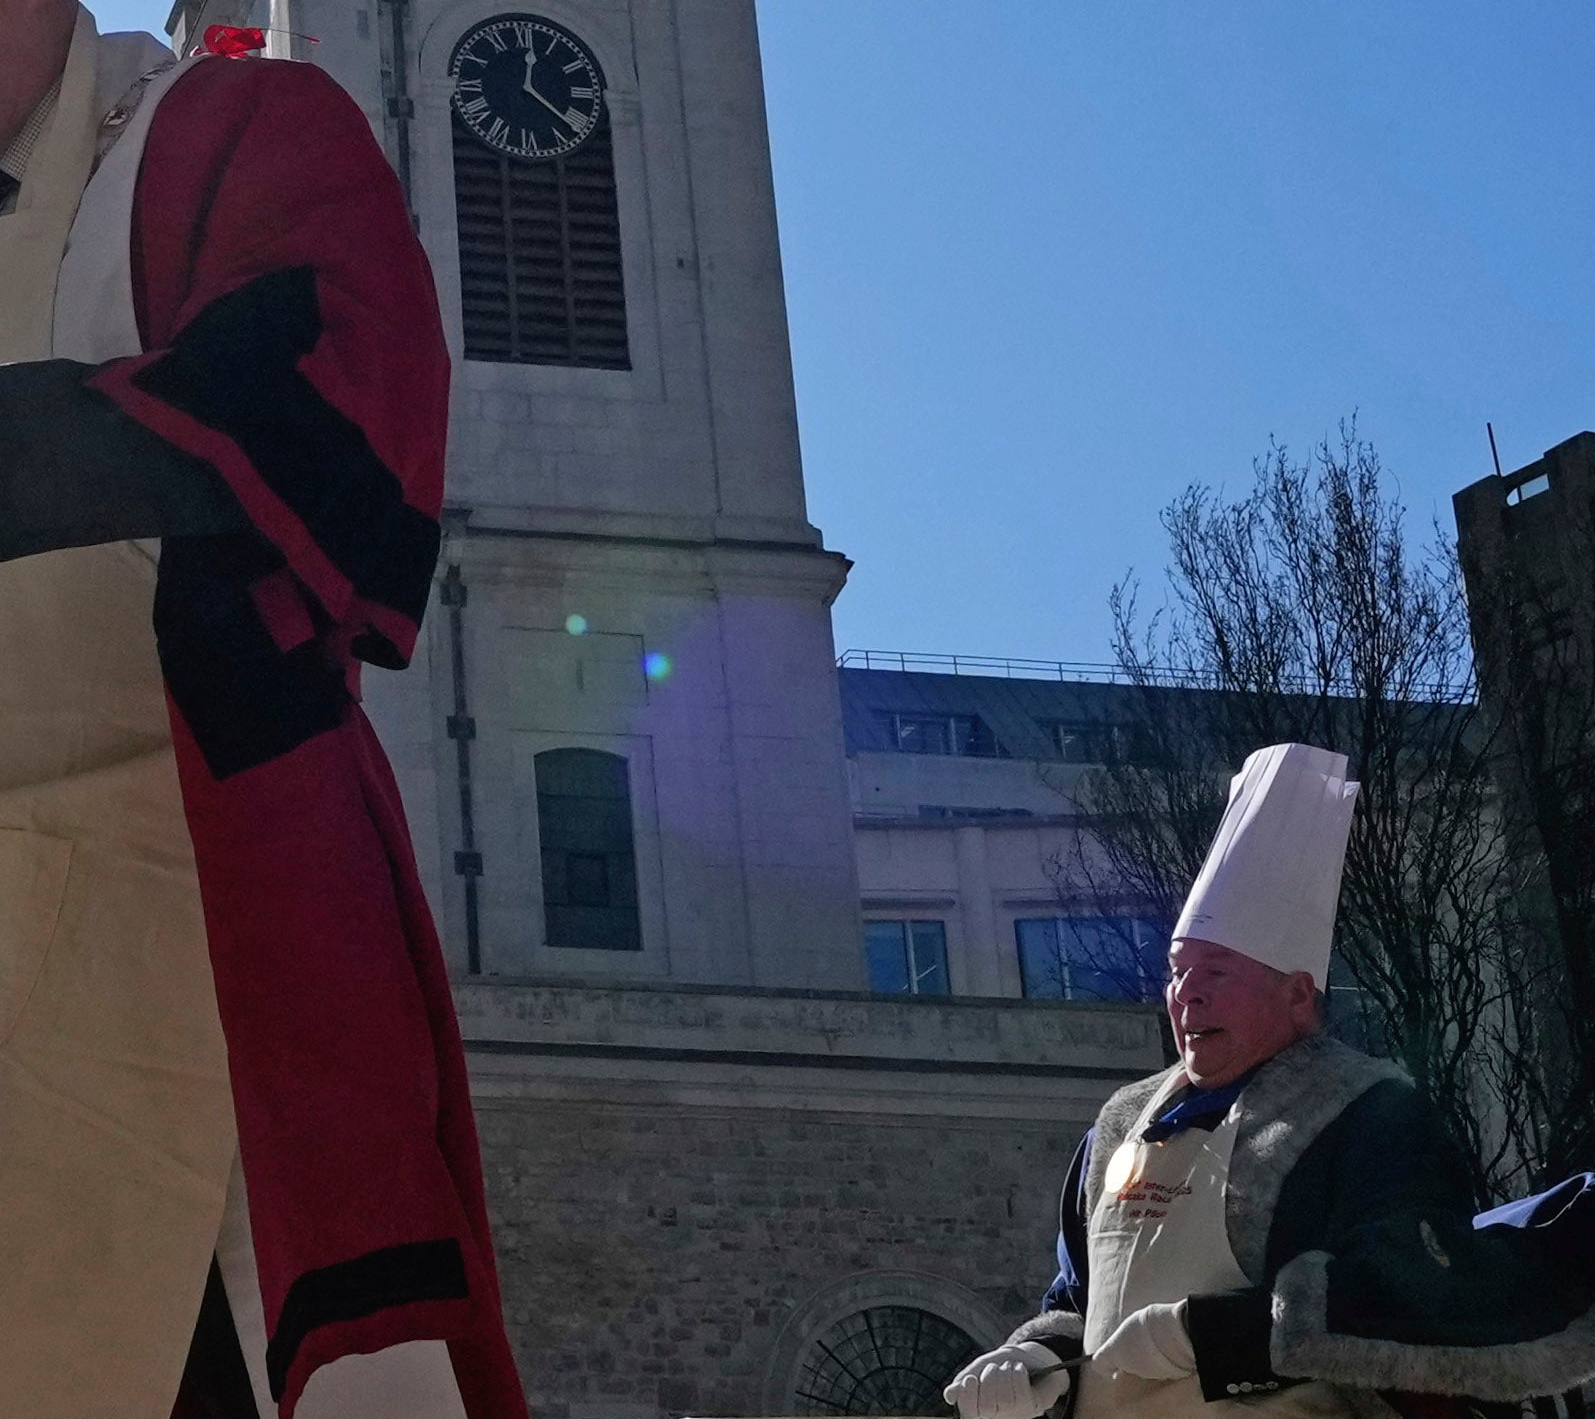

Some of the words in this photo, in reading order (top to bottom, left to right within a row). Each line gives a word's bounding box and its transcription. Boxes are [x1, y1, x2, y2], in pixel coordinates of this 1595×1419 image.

[485, 31, 508, 54] XI
[515, 25, 532, 49] XII
[545, 38, 557, 55] I
[463, 51, 488, 68] X
[563, 59, 584, 74] II
[571, 86, 594, 99] III
[464, 97, 491, 124] VIII
[488, 117, 509, 143] VII
[521, 128, 537, 150] VI
